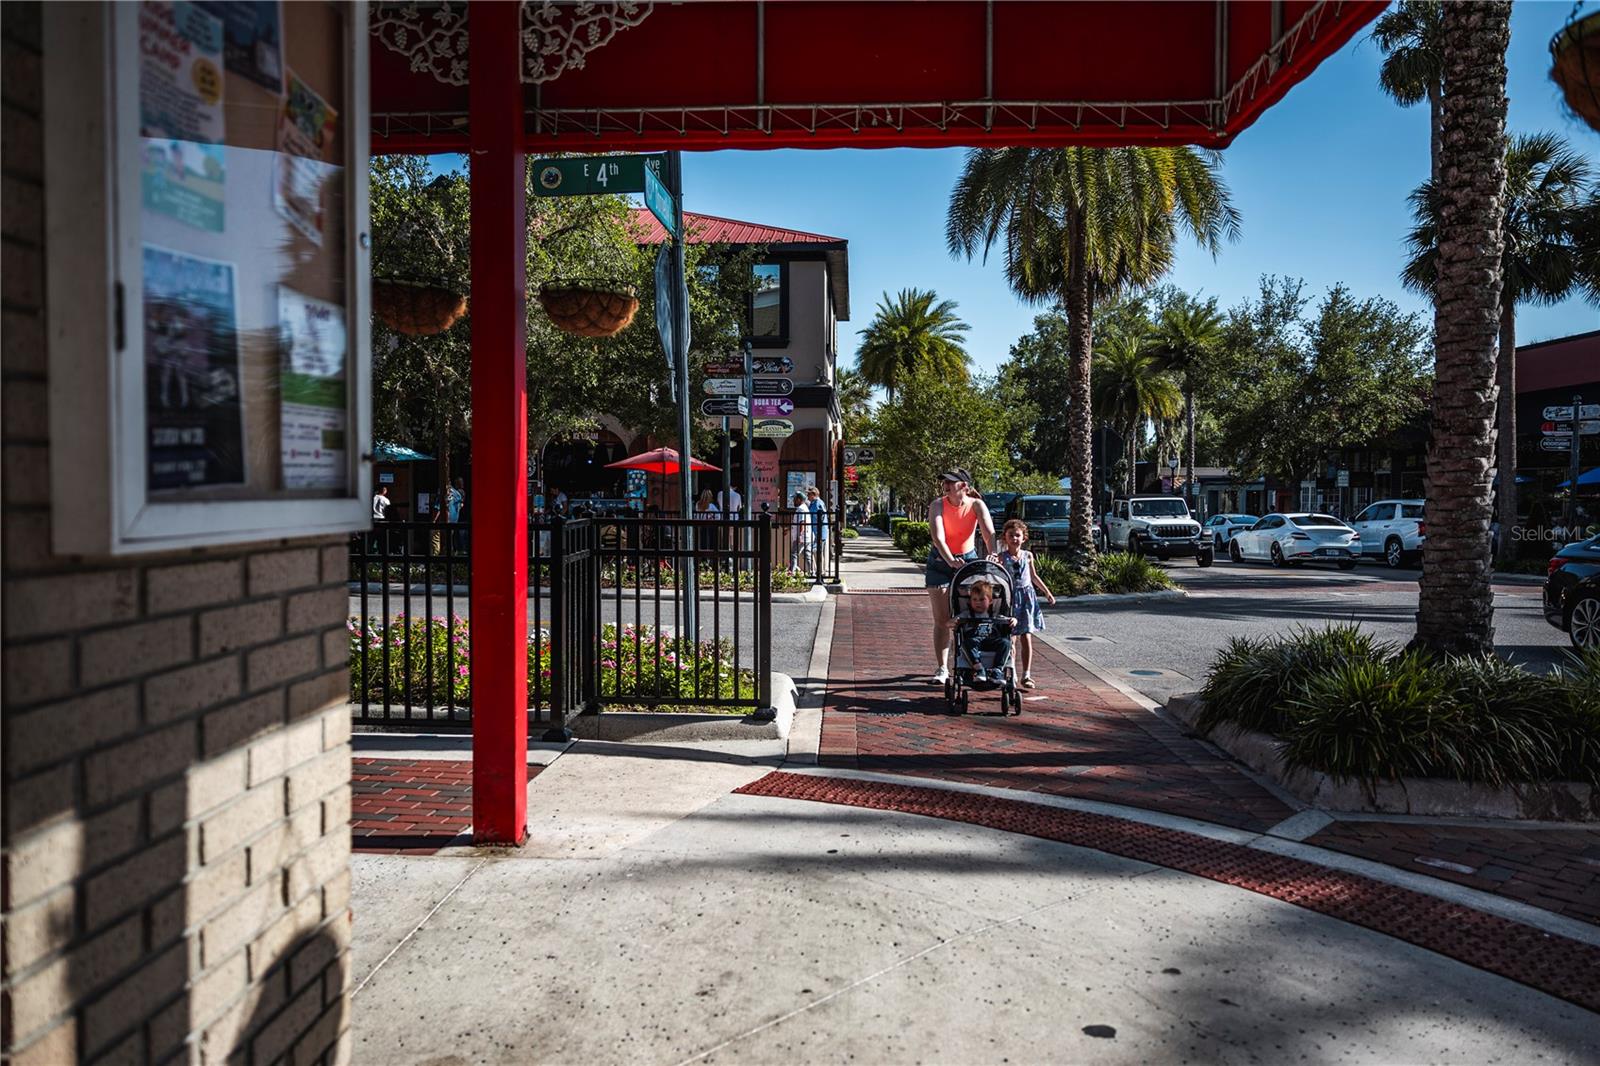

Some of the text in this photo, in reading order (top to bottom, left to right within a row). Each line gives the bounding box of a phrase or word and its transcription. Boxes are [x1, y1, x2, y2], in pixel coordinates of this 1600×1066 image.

[584, 163, 590, 177] E
[596, 163, 619, 188] 4th
[754, 398, 770, 406] BOBA
[771, 398, 782, 406] TEA
